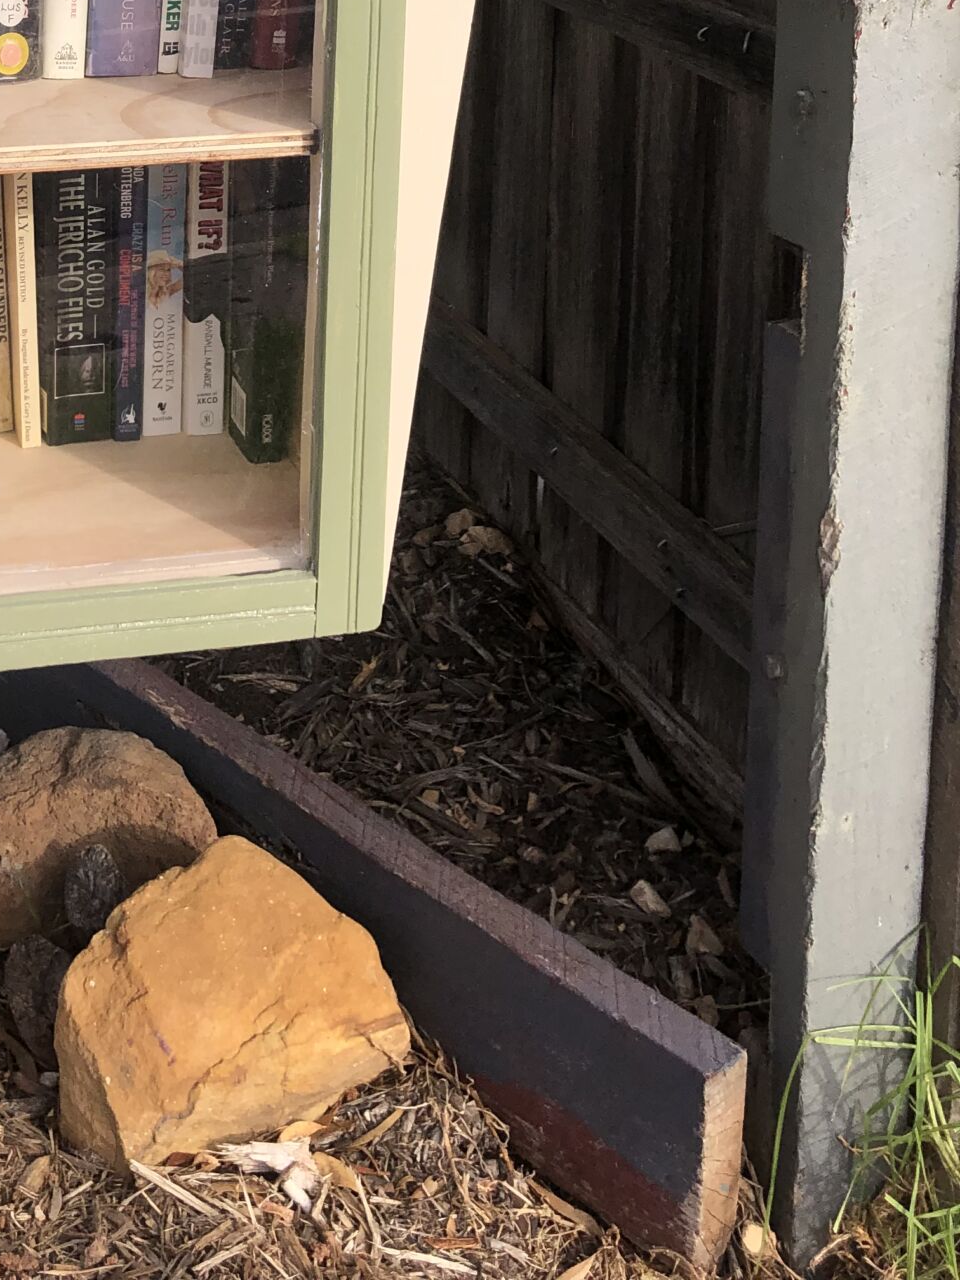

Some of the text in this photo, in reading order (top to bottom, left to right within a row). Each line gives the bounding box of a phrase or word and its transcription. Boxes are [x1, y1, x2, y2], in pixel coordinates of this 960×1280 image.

[0, 2, 21, 12] LUS
[7, 14, 15, 24] F
[16, 184, 30, 232] KELLY
[120, 168, 133, 219] OTTENBERG
[131, 222, 144, 262] CRAZY IS
[161, 207, 177, 246] Run
[197, 219, 224, 251] IF?
[53, 174, 85, 343] THE JERICHO FILES
[87, 205, 106, 308] ALAN GOLD
[19, 270, 27, 303] EDITION
[118, 249, 133, 306] COMPLIMENT
[151, 316, 165, 391] OSBORN
[165, 313, 177, 392] MARGARETA
[203, 320, 214, 356] RANDALL
[202, 358, 213, 389] MUNROE
[197, 397, 218, 405] XKCD
